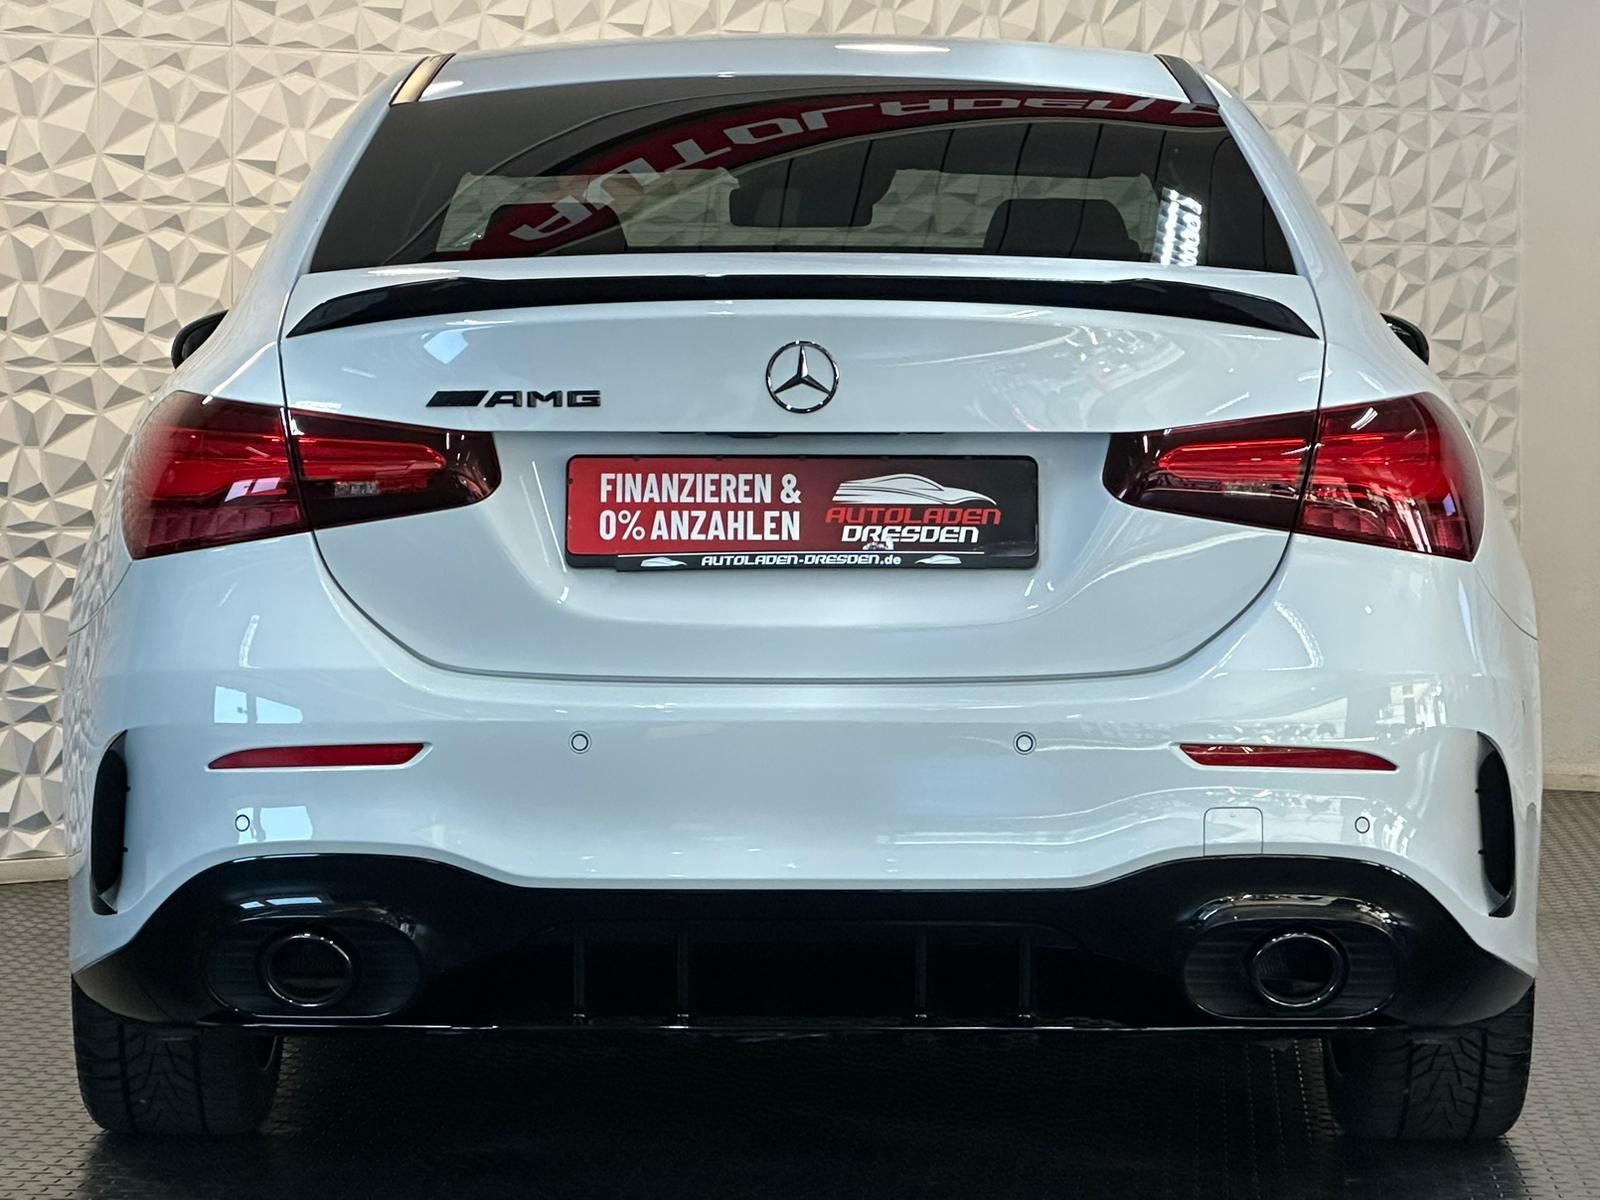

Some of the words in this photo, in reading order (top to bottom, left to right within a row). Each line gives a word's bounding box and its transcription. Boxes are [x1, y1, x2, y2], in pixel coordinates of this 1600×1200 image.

[485, 390, 601, 407] AMG
[600, 473, 772, 503] FINANZIEREN
[780, 473, 801, 504] &
[825, 507, 1001, 525] AUTOLADEN
[599, 510, 646, 541] 0%
[650, 510, 801, 541] ANZAHLEN
[841, 525, 979, 543] DRESDEN
[701, 554, 902, 567] AUTOLADEN-DRESDEN.de
